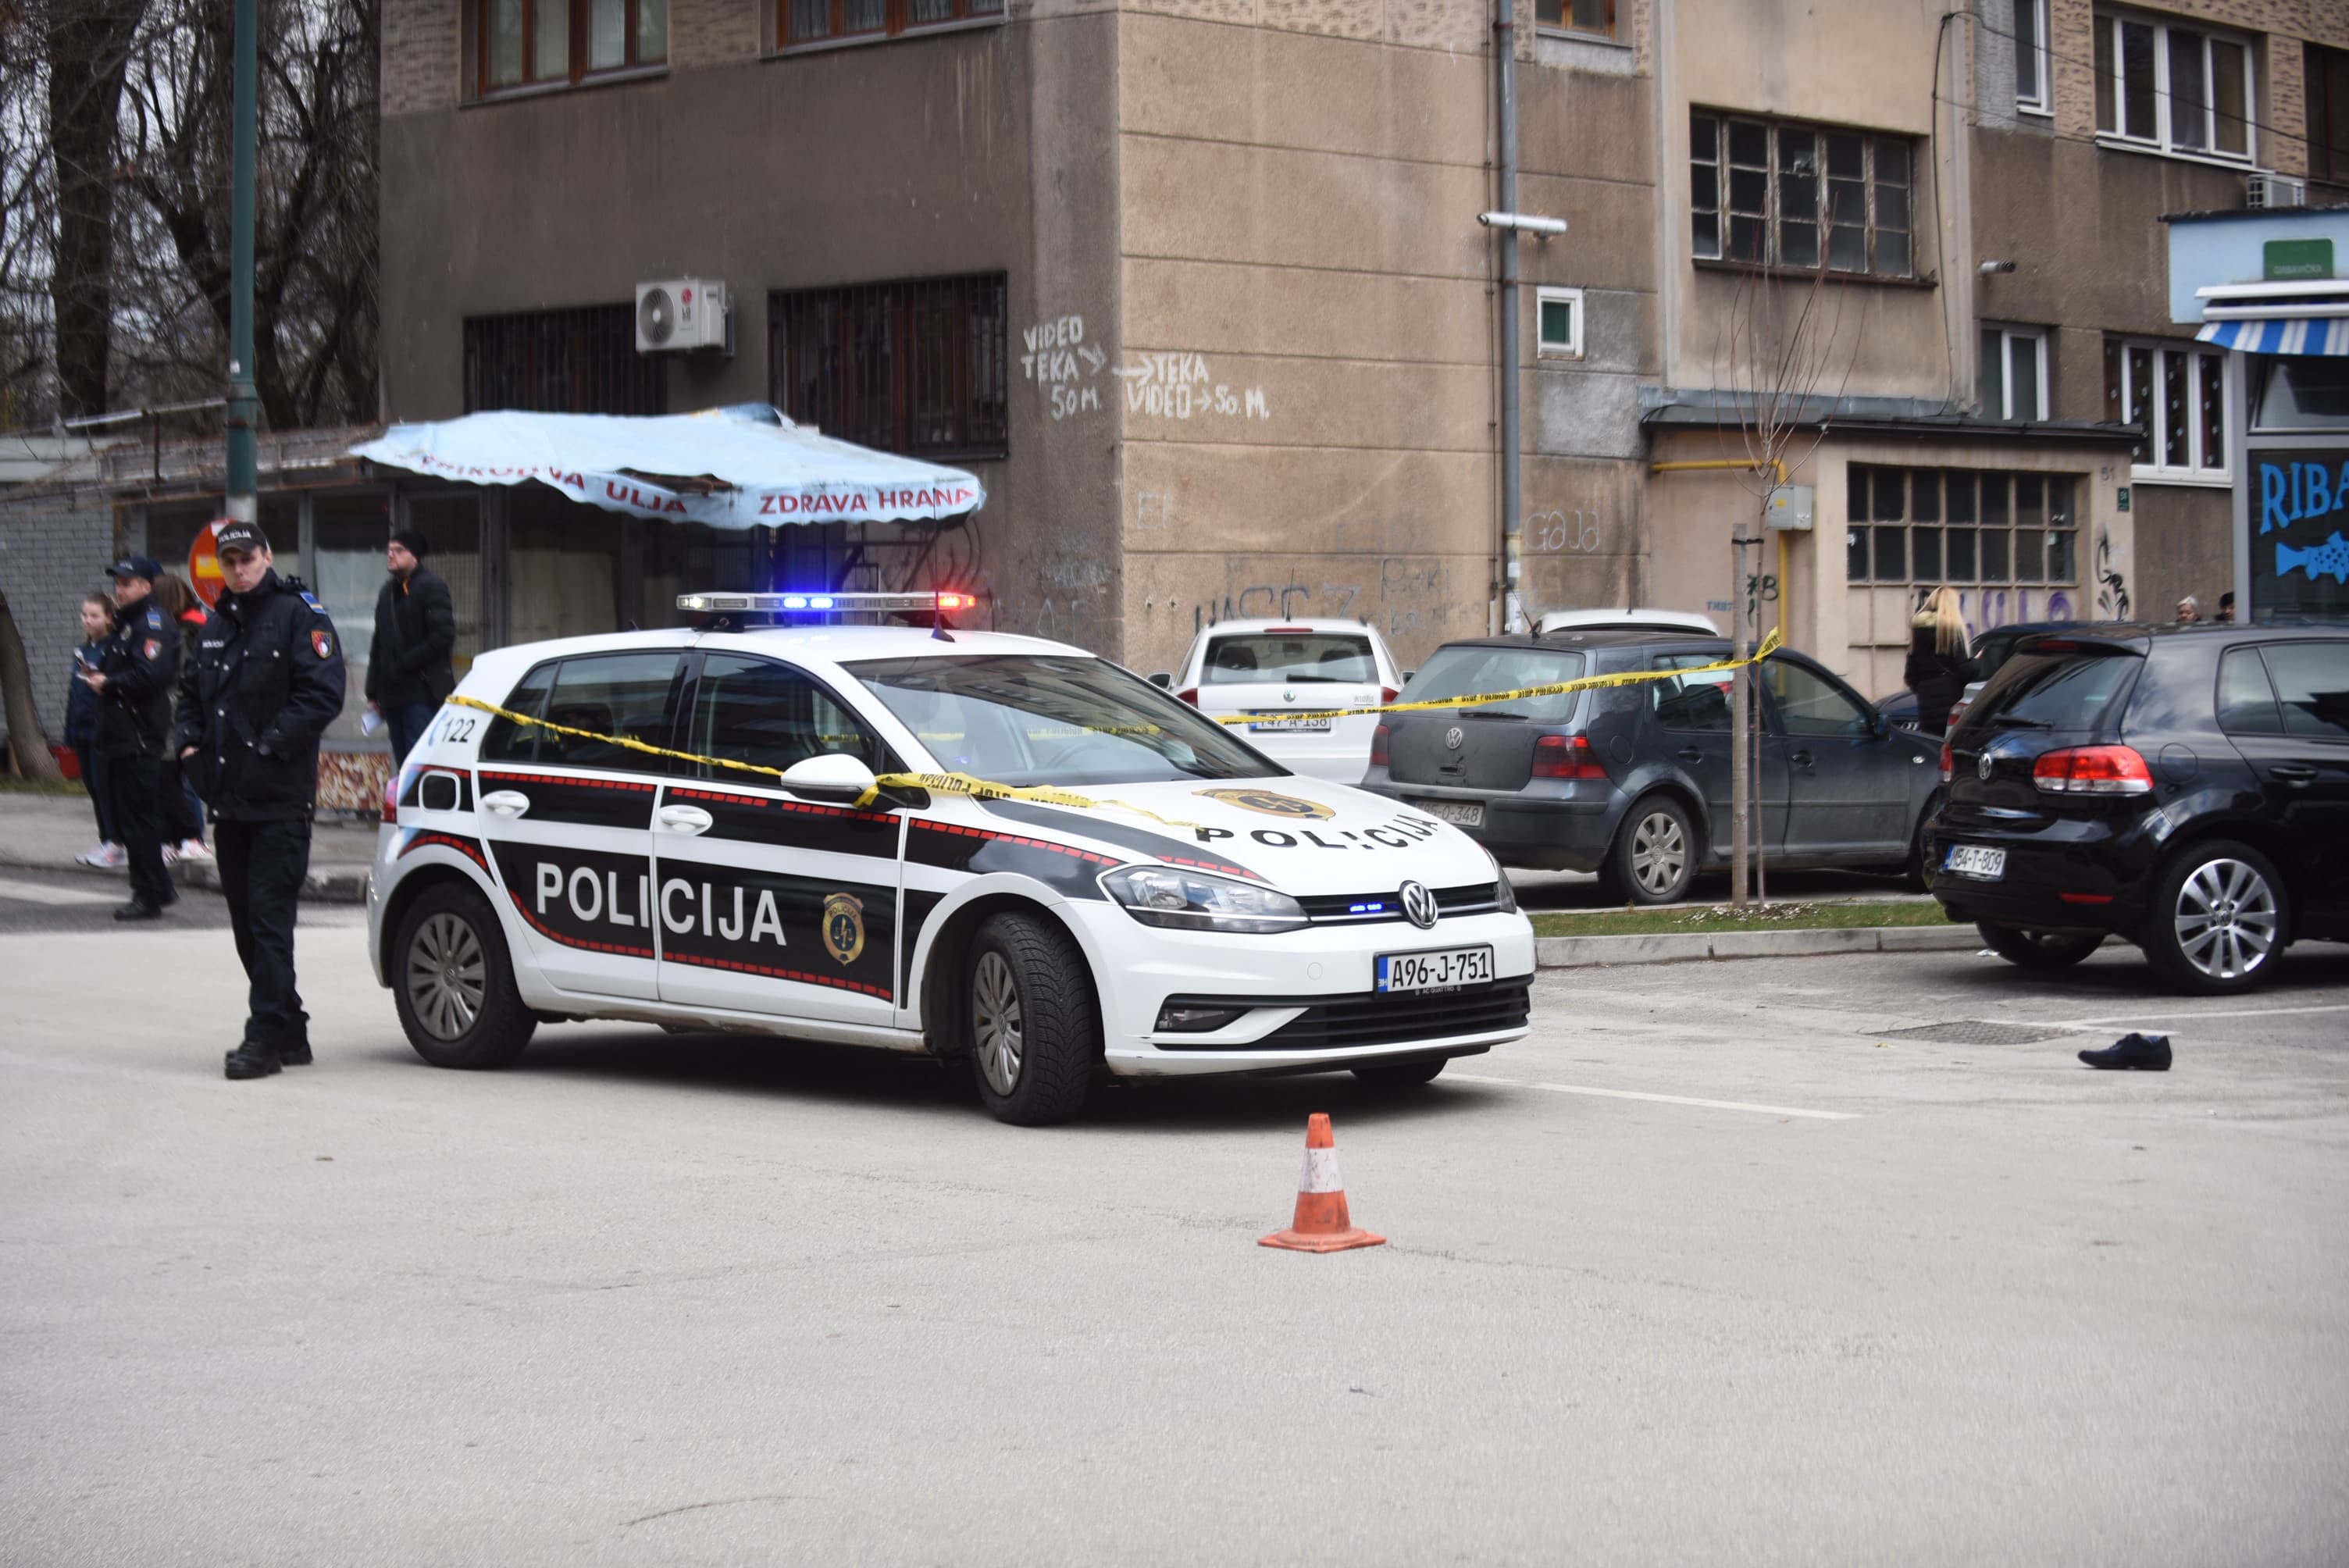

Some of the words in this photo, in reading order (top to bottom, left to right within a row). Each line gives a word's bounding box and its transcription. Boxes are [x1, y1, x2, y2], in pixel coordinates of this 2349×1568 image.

[1023, 315, 1084, 352] VIDEO
[1021, 351, 1078, 386] TEKA
[1156, 353, 1210, 383] TEKA
[1128, 382, 1191, 419] VIDEO
[606, 480, 688, 514] ULJA
[758, 493, 868, 515] ZDRAVA
[878, 487, 975, 511] HRANA
[443, 718, 476, 743] 122
[1195, 814, 1438, 850] POLICIJA
[536, 861, 787, 947] POLICIJA
[1392, 951, 1489, 988] A96-J-751
